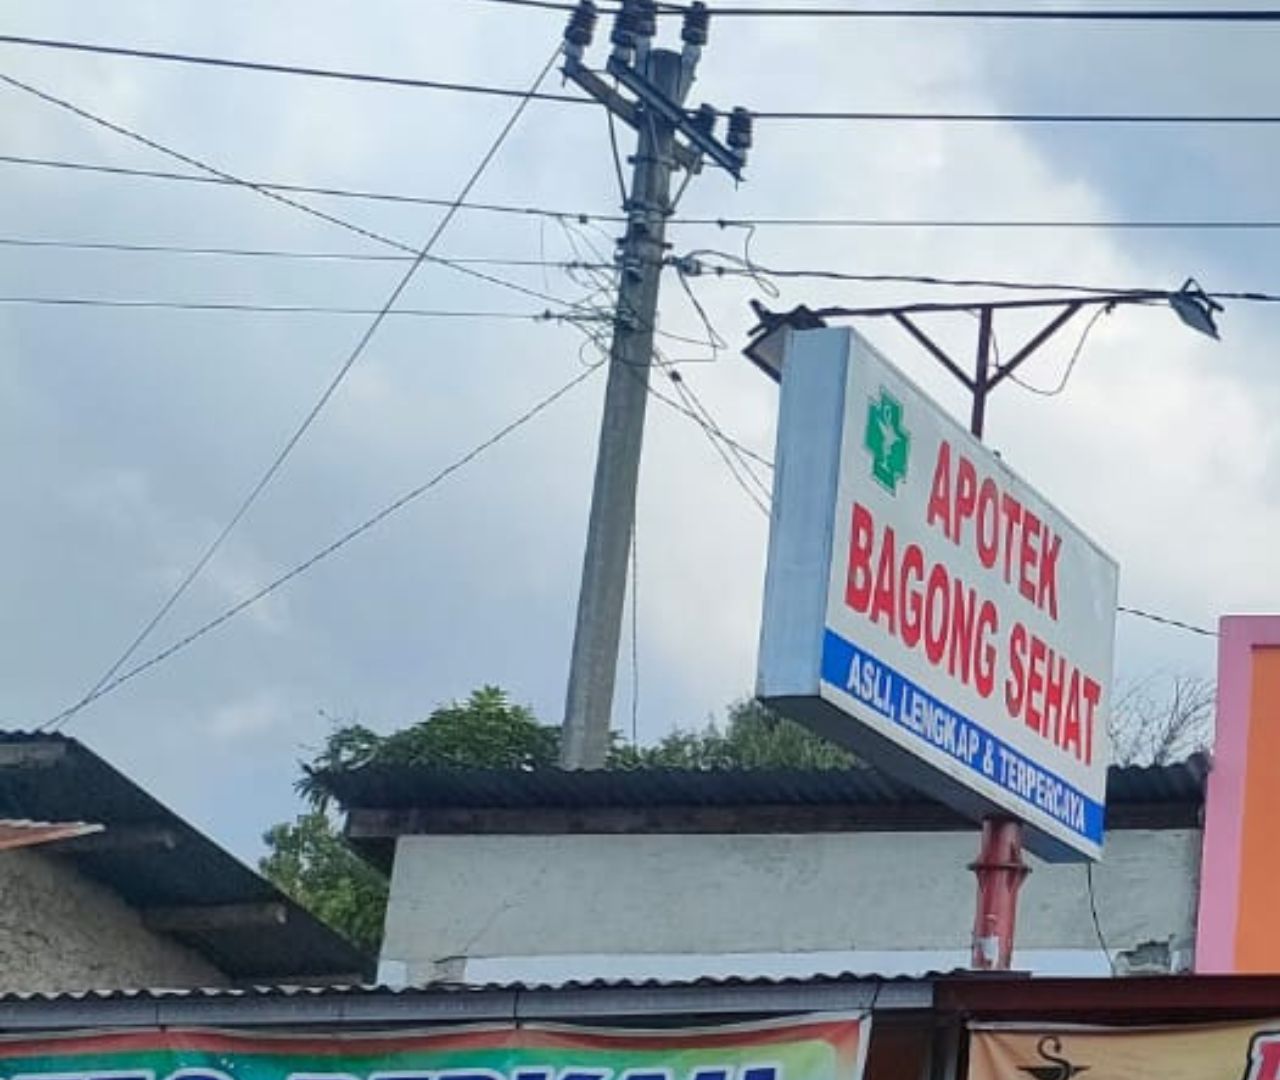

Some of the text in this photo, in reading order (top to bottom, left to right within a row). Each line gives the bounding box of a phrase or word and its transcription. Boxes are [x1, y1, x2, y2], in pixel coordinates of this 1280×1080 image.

[927, 440, 1063, 620] APOTEK
[845, 503, 1102, 767] BAGONG SEHAT
[901, 686, 979, 764] LENGKAP
[983, 739, 995, 777] &
[999, 745, 1086, 833] TERPERCAYA
